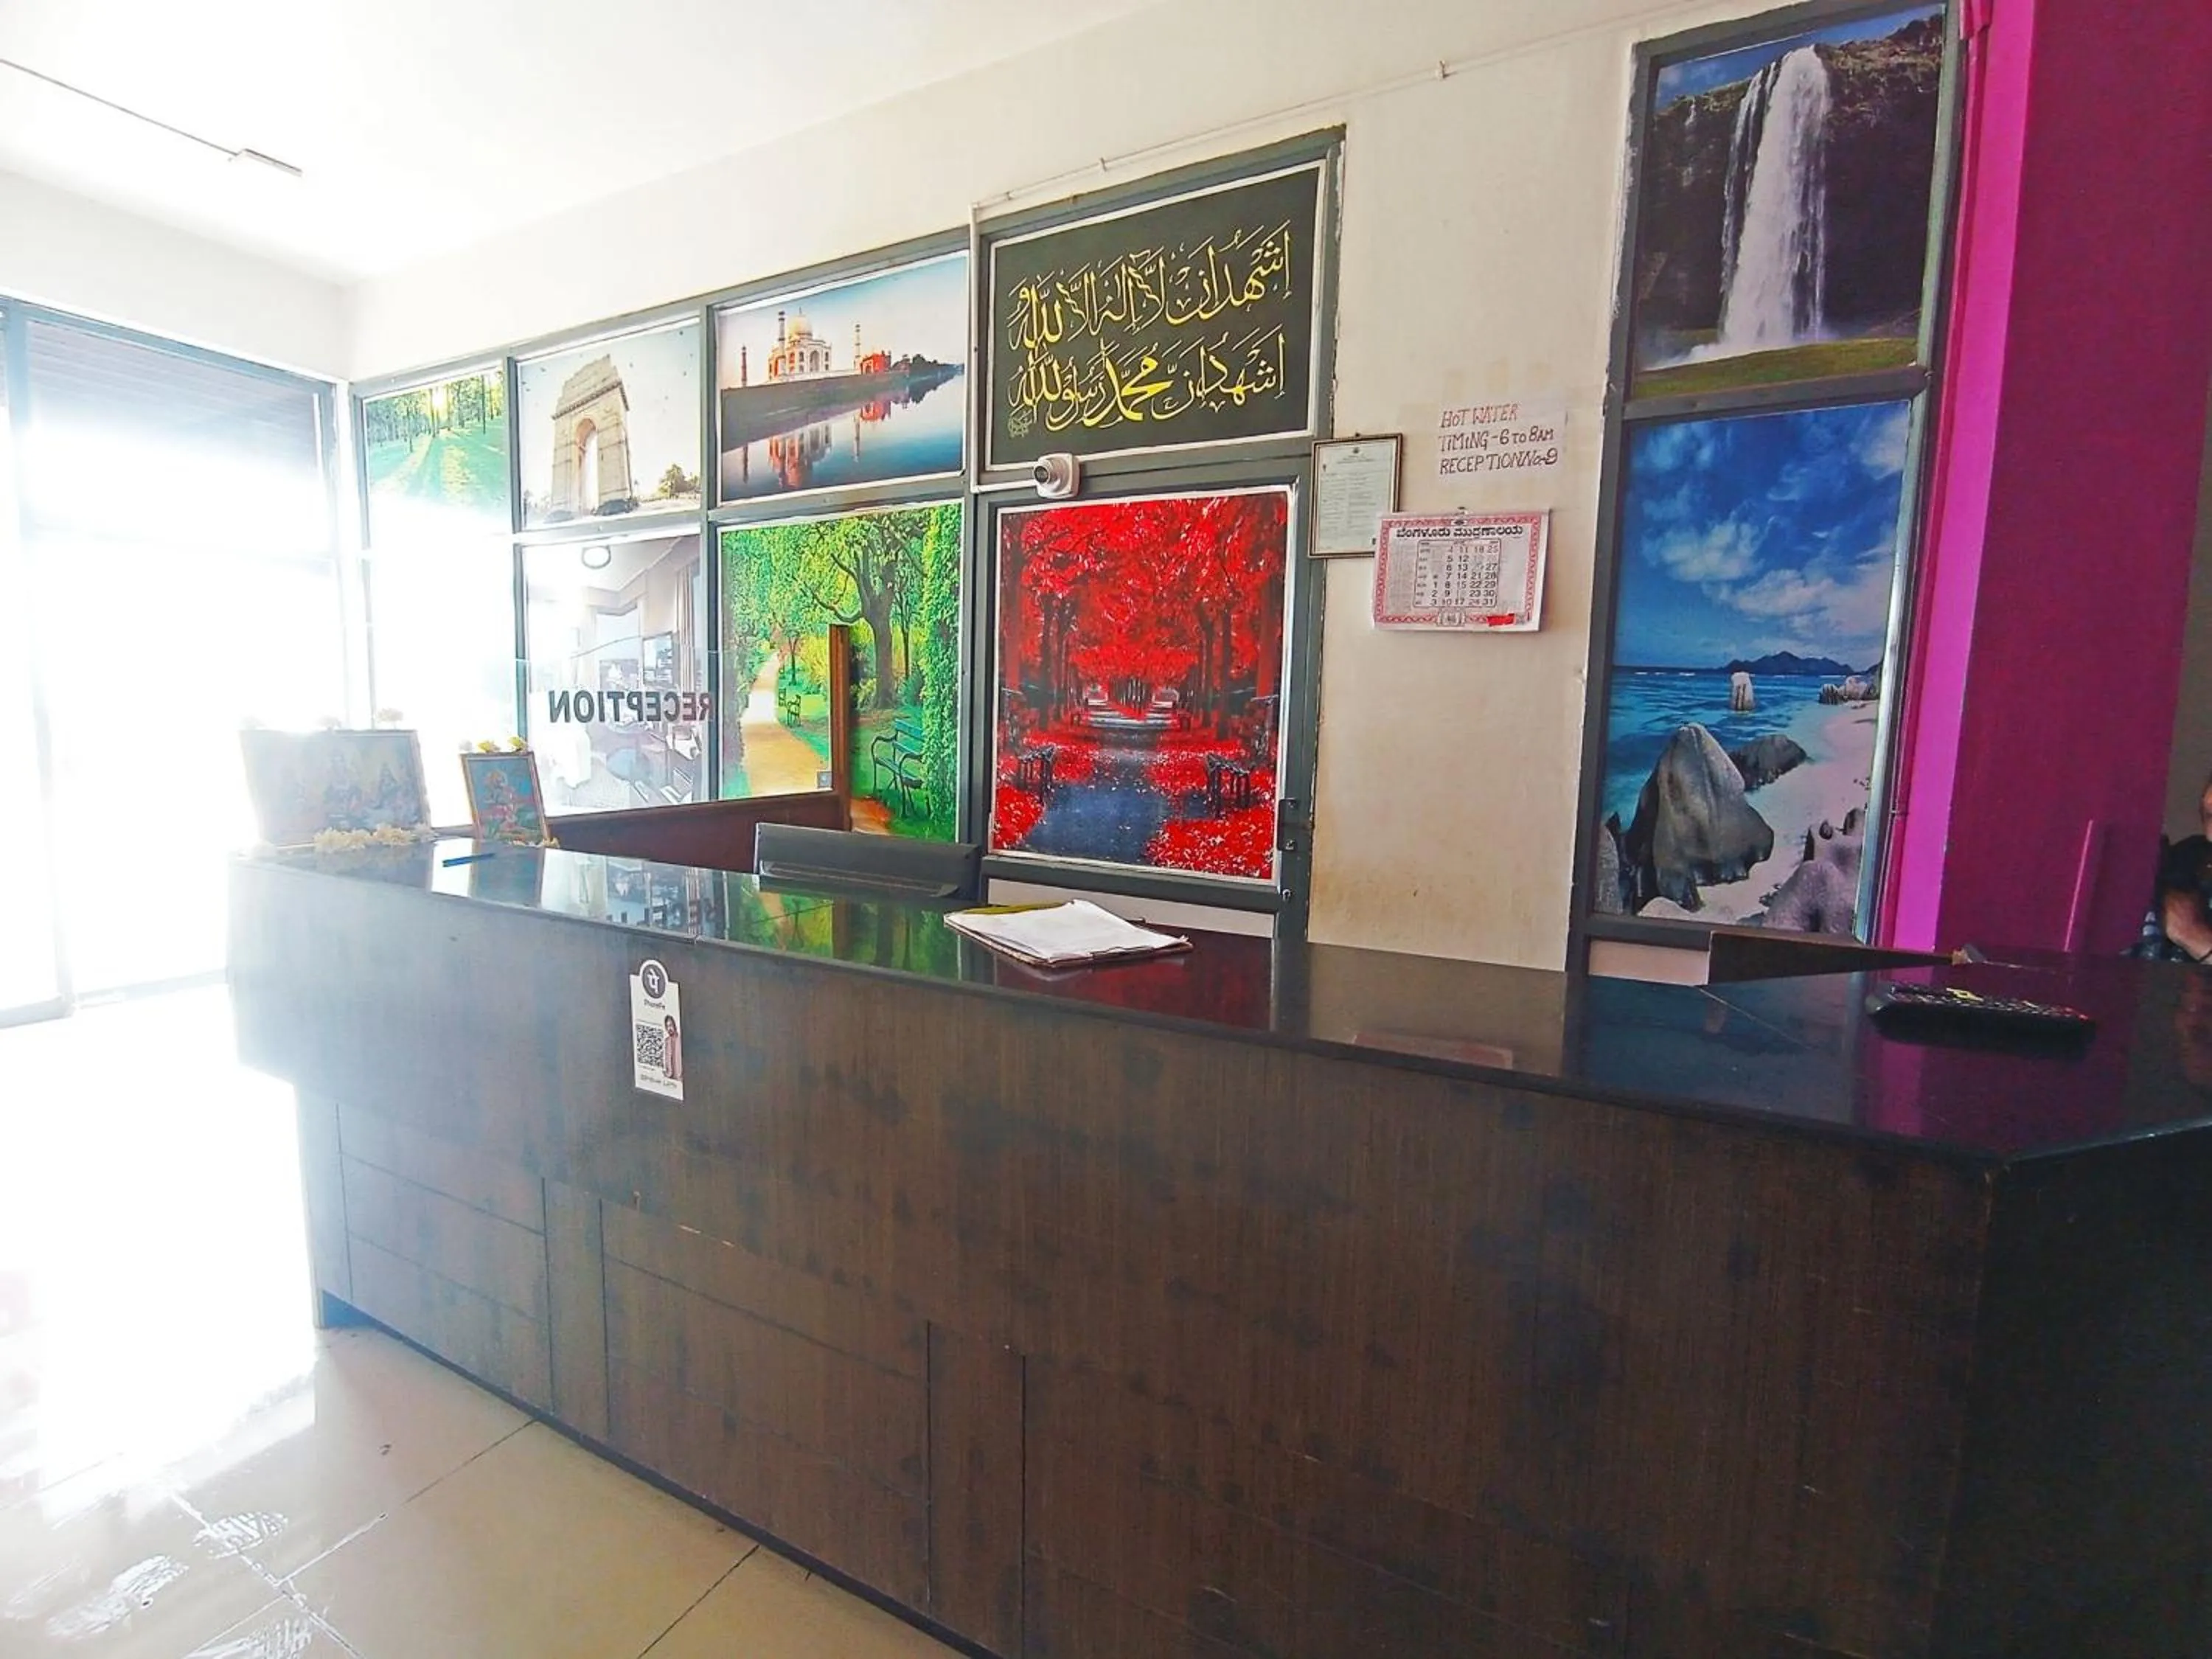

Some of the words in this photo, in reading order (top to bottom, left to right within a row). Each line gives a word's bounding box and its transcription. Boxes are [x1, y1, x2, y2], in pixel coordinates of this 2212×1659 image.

[1473, 403, 1519, 425] WATER
[1470, 580, 1481, 588] 22
[1469, 589, 1481, 597] 23
